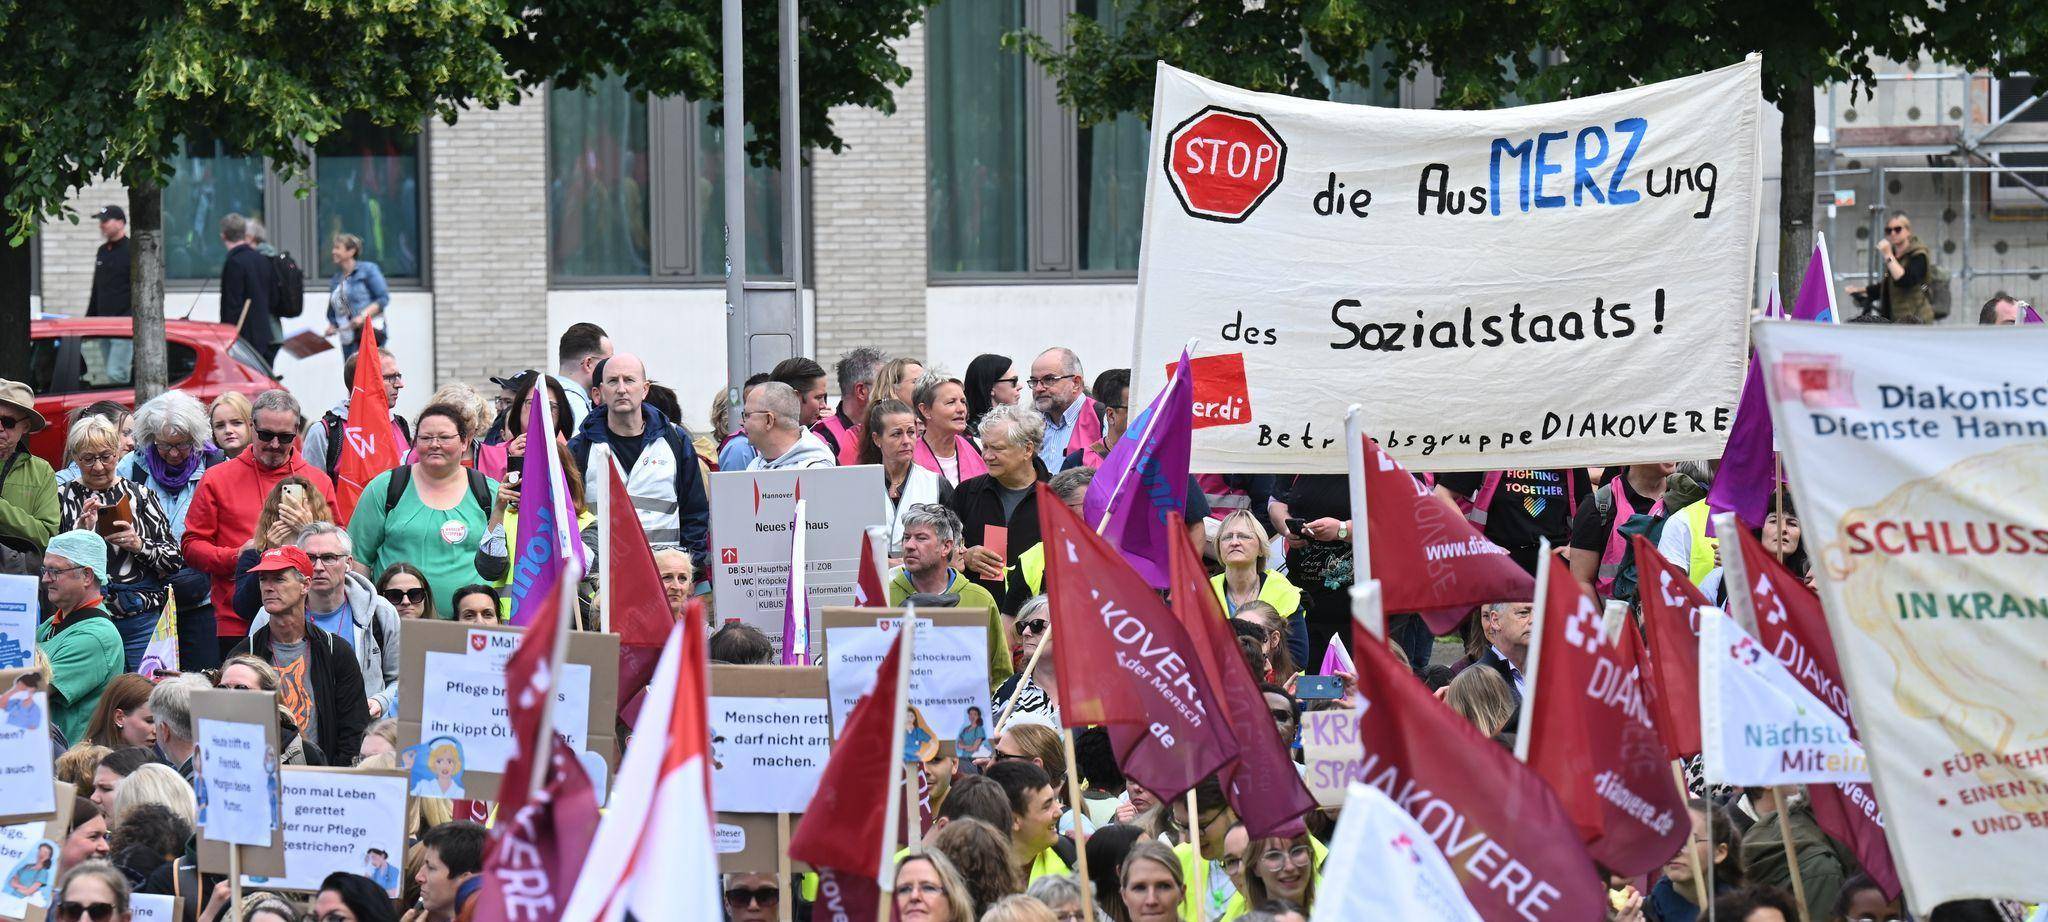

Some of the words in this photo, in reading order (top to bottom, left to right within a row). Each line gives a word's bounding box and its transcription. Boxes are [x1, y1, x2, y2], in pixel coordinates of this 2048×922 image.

[1184, 135, 1275, 182] STOP
[1313, 172, 1371, 217] die
[1417, 116, 1718, 219] AusMERZung
[1221, 309, 1278, 345] des
[1878, 380, 2048, 411] Diakonisc
[1191, 395, 1243, 421] er.di
[1257, 422, 1534, 456] Betrbsgruppe
[1541, 406, 1732, 441] DIAKOVERE
[1810, 413, 1940, 440] Dienste
[1953, 415, 2048, 439] Hann
[1506, 470, 1560, 482] FIGHTING
[762, 492, 793, 500] Hannover
[1505, 483, 1564, 496] TOGETHER
[755, 522, 787, 533] Neues
[789, 520, 829, 532] Rhaus
[1845, 520, 2048, 556] SCHLUSS
[728, 566, 739, 575] DB
[741, 566, 746, 575] S
[748, 566, 754, 574] U
[817, 562, 832, 571] ZOB
[734, 578, 740, 586] U
[741, 577, 754, 586] WC
[758, 576, 787, 586] Kröpcke
[758, 588, 772, 598] City
[808, 585, 852, 595] Information
[758, 600, 784, 609] KUBUS
[1895, 591, 1940, 620] IN
[1947, 591, 2048, 620] KRAN
[491, 635, 517, 649] Mal
[841, 654, 873, 663] Schon
[446, 681, 489, 697] Pflege
[492, 685, 507, 697] br
[909, 682, 919, 690] er
[907, 697, 923, 705] eis
[924, 696, 975, 706] gesessen?
[1150, 676, 1203, 729] Mensch
[491, 708, 509, 717] un
[725, 711, 800, 724] Menschen
[804, 713, 830, 725] rett
[431, 720, 450, 732] ihr
[452, 722, 488, 738] kippt
[491, 724, 507, 738] Öl
[734, 732, 764, 745] darf
[767, 732, 804, 746] nicht
[752, 755, 816, 768] machen.
[1780, 749, 1868, 774] Mitein
[1941, 752, 1990, 778] FÜR
[1993, 746, 2048, 769] MEH
[5, 764, 35, 775] auch
[1314, 758, 1362, 789] SPA
[282, 784, 307, 796] hon
[309, 787, 335, 798] mal
[337, 788, 377, 801] Leben
[1958, 779, 2028, 806] EINEN
[294, 805, 345, 817] gerettet
[1971, 814, 2023, 836] UND
[2025, 810, 2048, 829] BE
[302, 823, 324, 834] nur
[327, 823, 367, 838] Pflege
[715, 828, 742, 838] alteser
[0, 843, 24, 859] ber
[133, 906, 153, 918] ine
